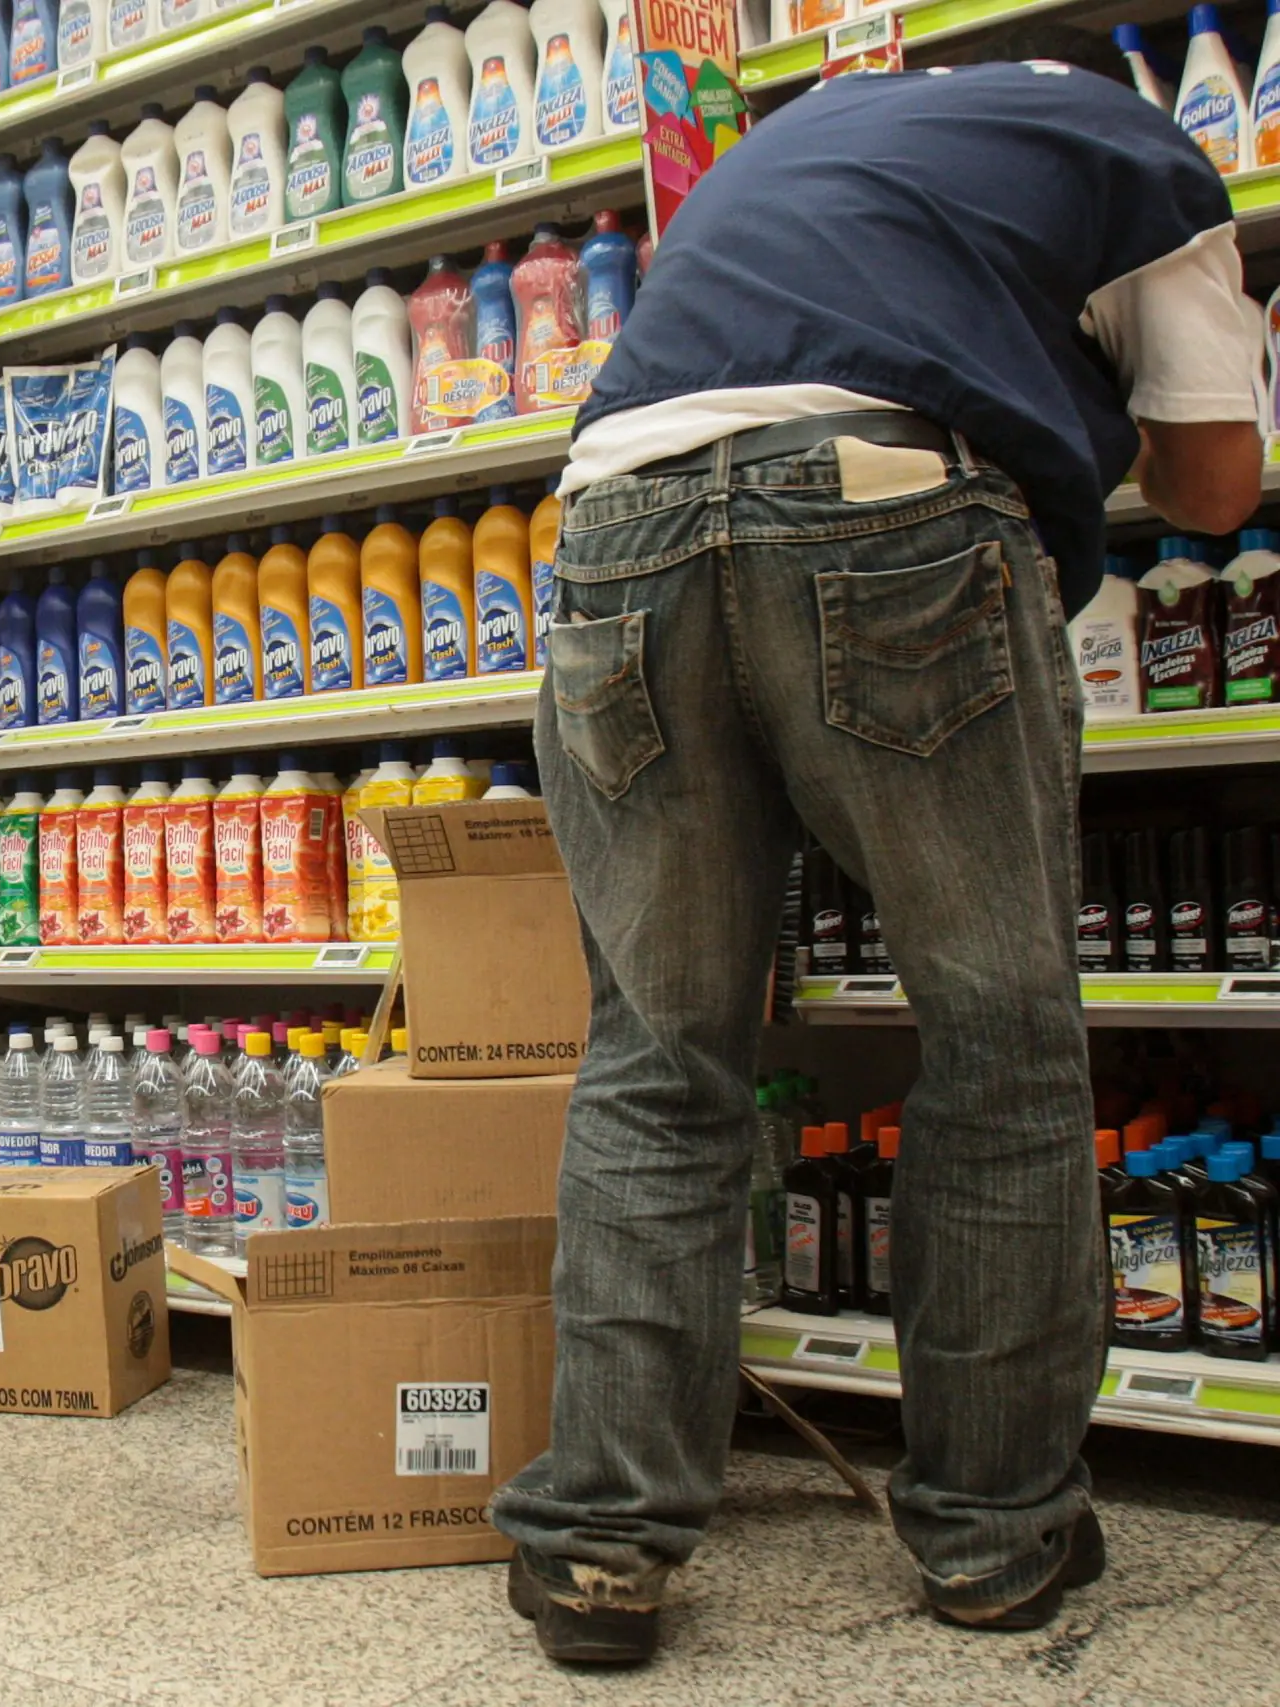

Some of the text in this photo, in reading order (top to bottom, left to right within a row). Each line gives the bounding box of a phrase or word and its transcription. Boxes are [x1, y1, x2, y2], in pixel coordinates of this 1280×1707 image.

[649, 0, 730, 61] ORDEM
[363, 157, 389, 180] MAX
[302, 176, 326, 198] MAX
[245, 195, 268, 215] MAX
[191, 211, 213, 232] MAX
[140, 228, 162, 246] MAX
[424, 621, 461, 652] bravo
[477, 611, 519, 643] bravo
[1080, 637, 1123, 666] Ingleza
[1141, 625, 1205, 667] INGLEZA
[264, 642, 296, 674] bravo
[1149, 654, 1196, 675] Madeiras
[81, 667, 113, 696] bravo
[128, 661, 160, 689] bravo
[1154, 664, 1192, 683] Escuras
[126, 827, 156, 847] Brilho
[167, 826, 198, 845] Brilho
[217, 821, 248, 842] Brilho
[265, 816, 296, 837] Brilho
[347, 820, 362, 839] Bri
[1, 834, 26, 852] Brilho
[41, 833, 66, 852] Brilho
[80, 830, 109, 850] Brilho
[417, 1041, 577, 1063] CONTÉM: 24 FRASCOS
[349, 1247, 442, 1262] Empilhamento
[1114, 1243, 1175, 1272] Ingleza
[1200, 1252, 1256, 1277] Ingleza
[421, 1261, 465, 1274] Caixas
[20, 1391, 52, 1408] COM
[55, 1391, 98, 1410] 750ML
[406, 1389, 482, 1411] 603926
[286, 1510, 374, 1537] CONTÉM
[382, 1513, 403, 1530] 12
